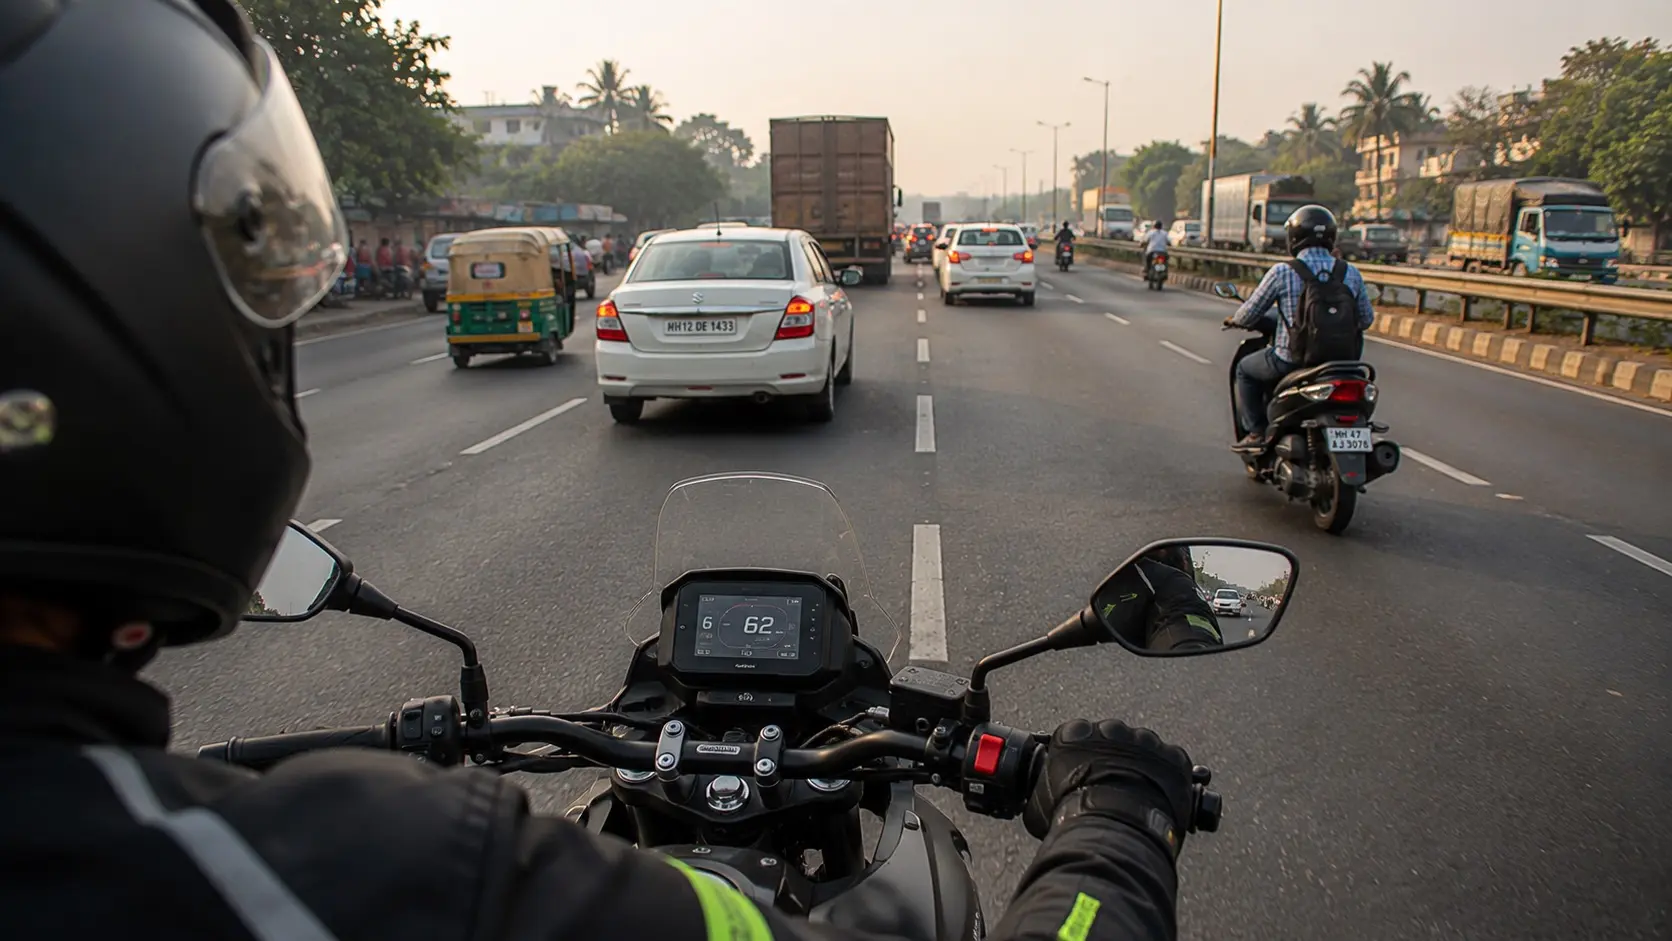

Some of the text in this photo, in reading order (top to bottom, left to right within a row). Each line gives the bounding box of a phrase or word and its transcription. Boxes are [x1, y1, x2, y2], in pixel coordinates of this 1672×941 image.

[667, 321, 734, 332] MH12 DE 1433
[1351, 430, 1361, 438] 47
[702, 616, 774, 634] 6 62
